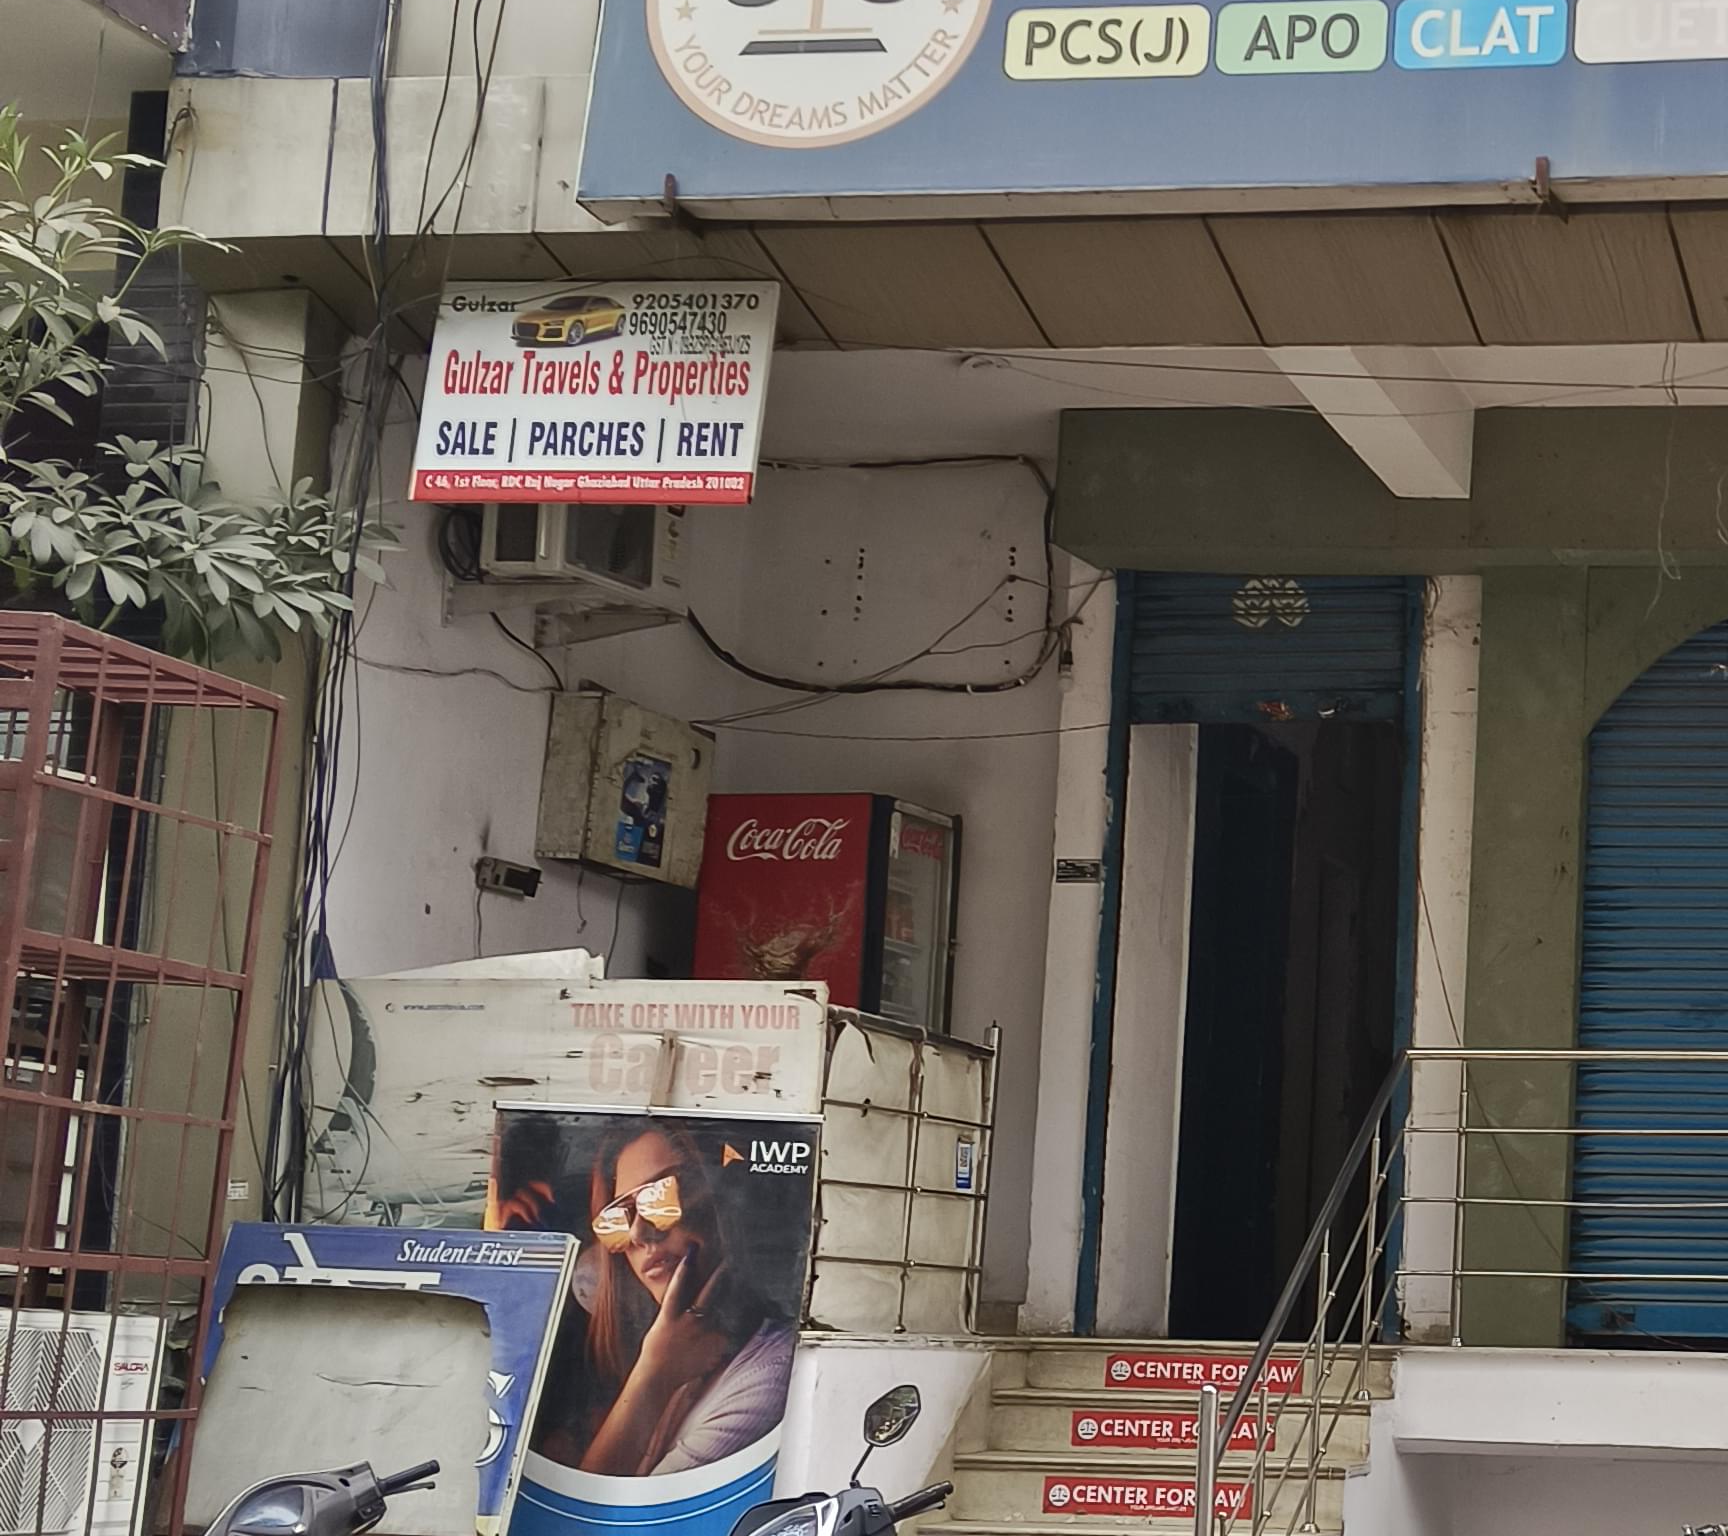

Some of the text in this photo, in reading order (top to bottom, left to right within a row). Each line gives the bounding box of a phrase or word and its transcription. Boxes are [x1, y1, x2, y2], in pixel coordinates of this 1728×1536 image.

[1024, 16, 1191, 68] PCS(J)
[1243, 13, 1361, 62] APO
[1410, 4, 1555, 59] CLAT
[673, 27, 960, 131] YOUR DREAMS MATTER
[451, 293, 760, 313] Gulzar 9205401370
[443, 349, 751, 406] Gulzar Travels & Properties
[436, 420, 745, 458] SALE PARCHES RENT
[726, 818, 851, 861] Coca-Cola
[570, 1003, 801, 1031] TAKE OFF WITH YOUR
[588, 1032, 780, 1096] Career
[750, 1140, 811, 1164] IWP
[749, 1163, 809, 1175] ACADEMY
[1133, 1361, 1205, 1380] CENTER
[1101, 1419, 1174, 1438] CENTER
[1072, 1485, 1147, 1505] CENTER
[1155, 1487, 1196, 1506] FOR
